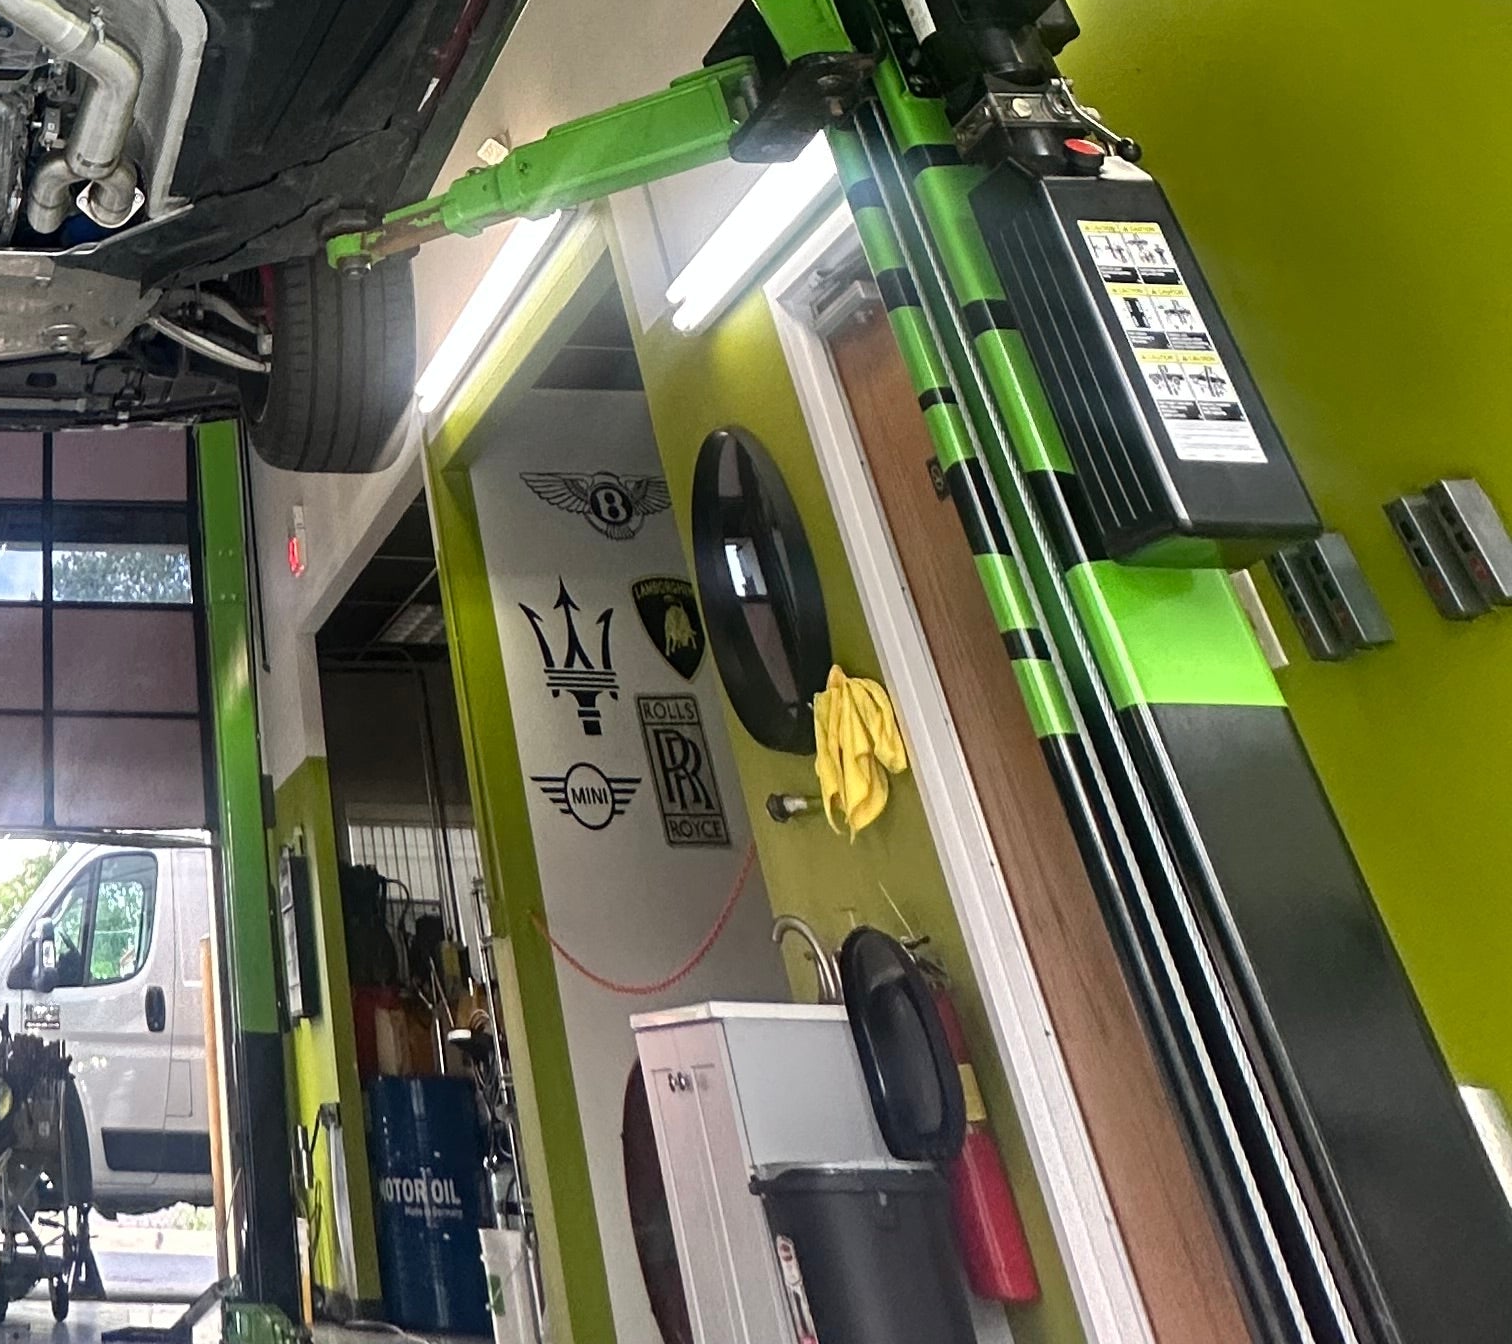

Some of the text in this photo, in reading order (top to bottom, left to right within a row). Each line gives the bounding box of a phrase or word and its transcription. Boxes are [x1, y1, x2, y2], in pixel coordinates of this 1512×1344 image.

[642, 701, 695, 720] ROLLS
[571, 787, 610, 805] MINI
[668, 819, 723, 839] ROYCE
[379, 1176, 462, 1205] MOTOR OIL
